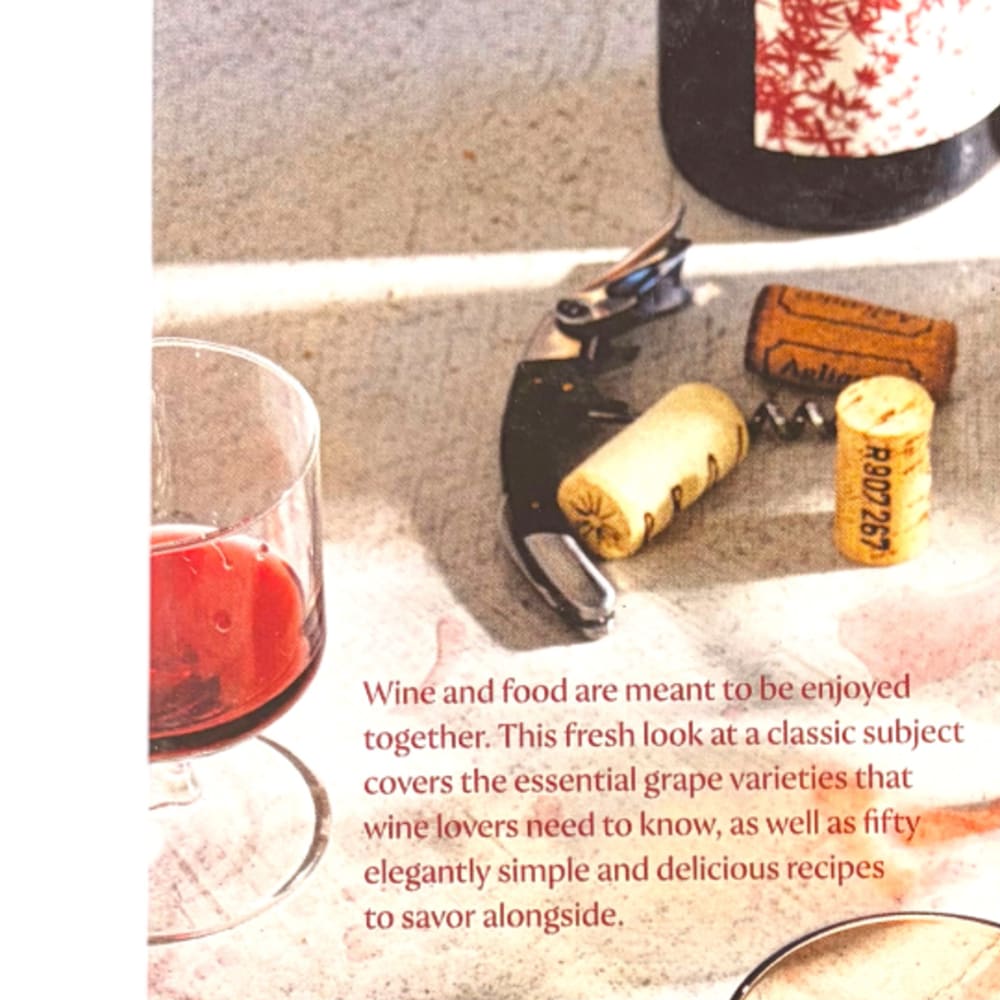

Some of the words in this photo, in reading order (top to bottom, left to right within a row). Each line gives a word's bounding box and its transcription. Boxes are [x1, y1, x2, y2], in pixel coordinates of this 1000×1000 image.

[363, 679, 436, 706] Wine
[442, 677, 495, 704] and
[502, 676, 568, 704] food
[574, 684, 618, 703] are
[625, 680, 715, 703] meant
[722, 680, 754, 702] to
[759, 673, 795, 702] be
[800, 673, 912, 706] enjoyed
[364, 723, 492, 757] together.
[497, 721, 558, 749] This
[564, 720, 635, 748] fresh
[642, 720, 704, 747] look
[710, 725, 738, 746] at
[744, 727, 761, 746] a
[766, 718, 857, 746] classic
[863, 718, 966, 750] subject
[363, 776, 454, 795] covers
[460, 767, 507, 795] the
[513, 765, 637, 794] essential
[643, 774, 724, 800] grape
[728, 765, 849, 791] varieties
[854, 763, 914, 791] that
[363, 814, 430, 840] wine
[436, 811, 519, 840] lovers
[525, 810, 595, 839] need
[602, 816, 633, 838] to
[639, 810, 723, 838] know,
[729, 817, 760, 836] as
[765, 808, 821, 836] well
[826, 815, 857, 836] as
[862, 808, 922, 844] fifty
[363, 858, 493, 891] elegantly
[497, 856, 591, 890] simple
[597, 855, 650, 882] and
[655, 854, 780, 882] delicious
[786, 855, 886, 887] recipes
[364, 909, 395, 930] to
[401, 909, 476, 930] savor
[482, 900, 625, 936] alongside.
